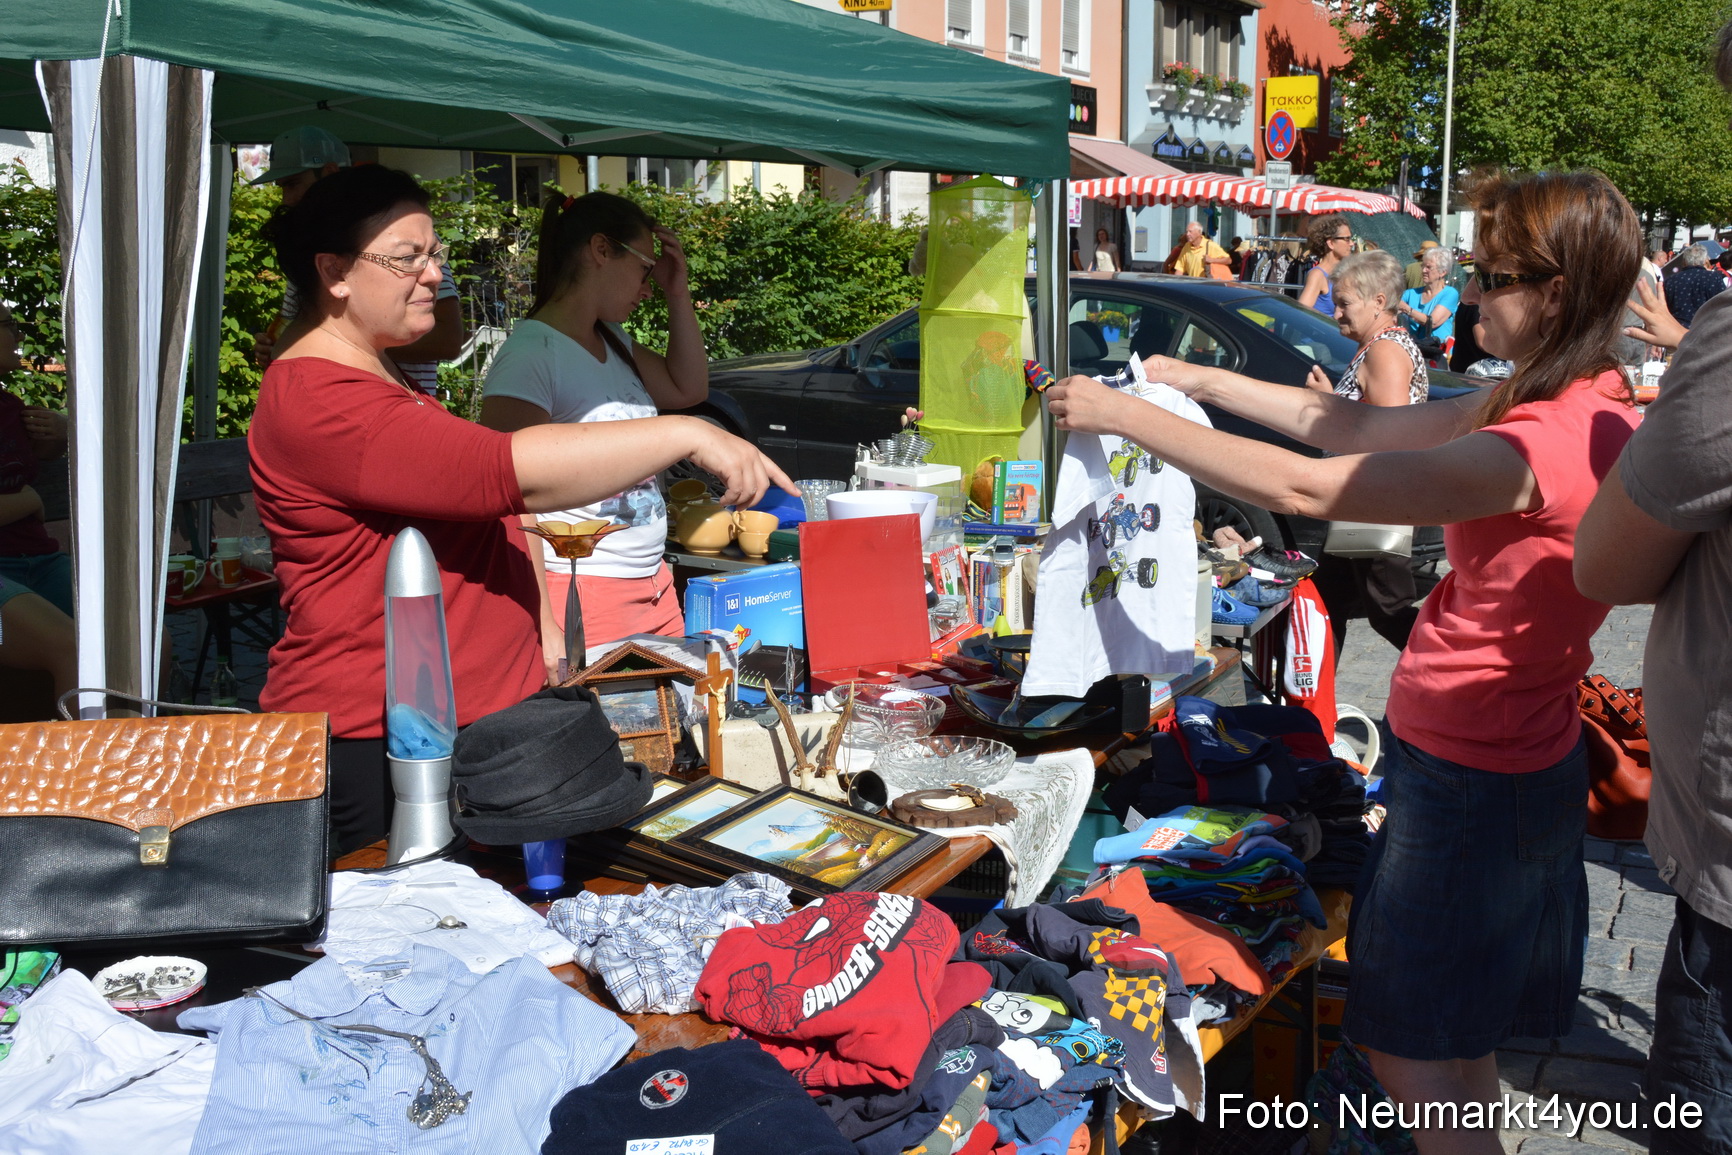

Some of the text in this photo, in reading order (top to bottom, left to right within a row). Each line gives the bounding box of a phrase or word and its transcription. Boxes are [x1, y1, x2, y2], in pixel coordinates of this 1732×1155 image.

[726, 590, 792, 611] 1&1 HomeServer
[1295, 677, 1314, 686] LIG
